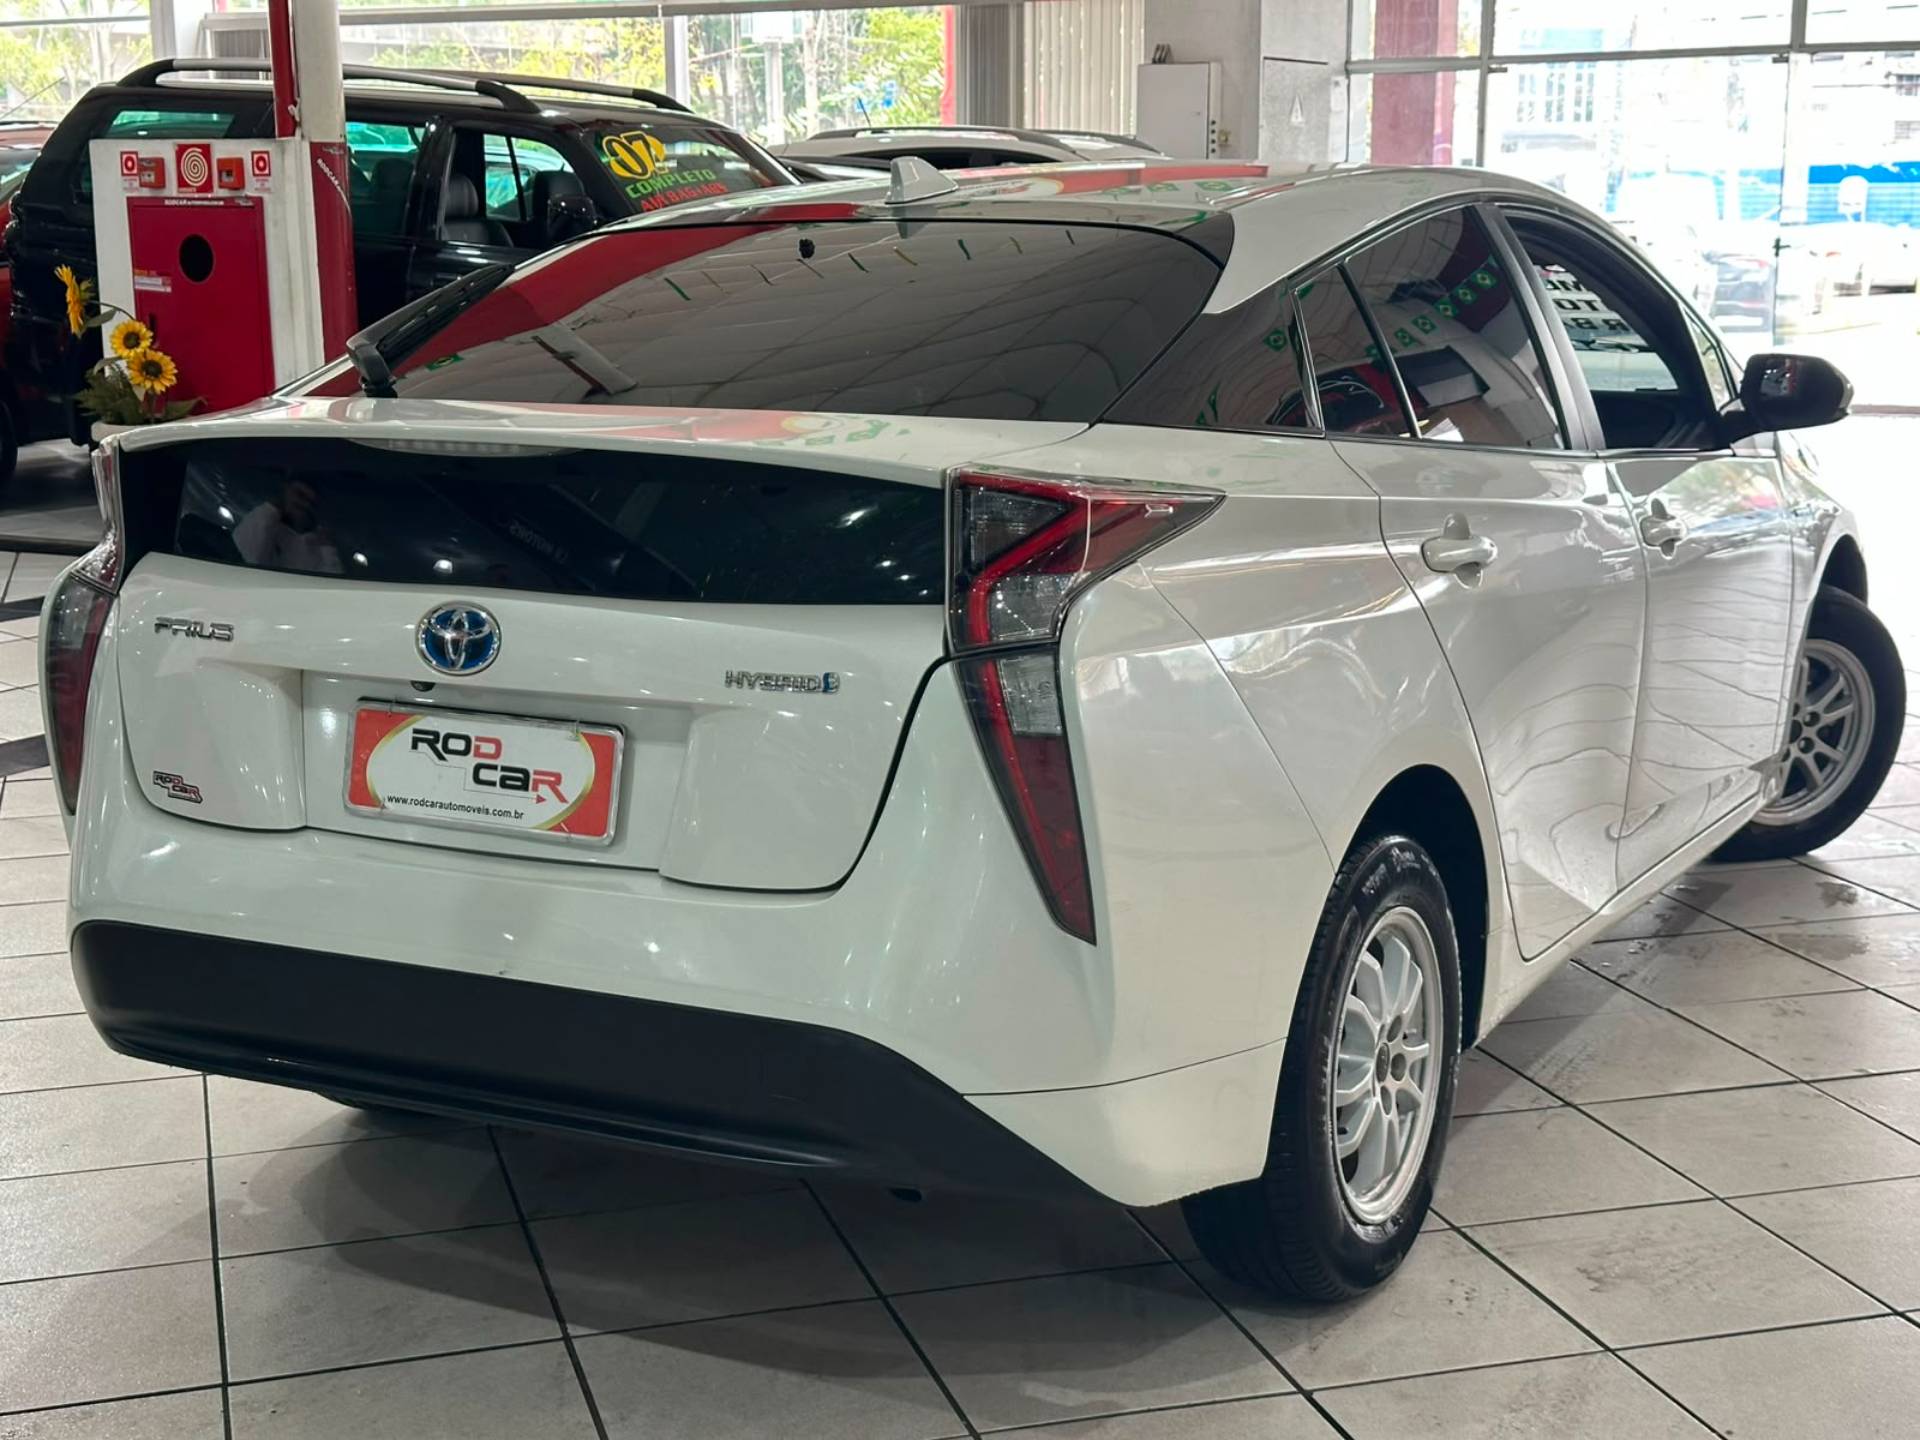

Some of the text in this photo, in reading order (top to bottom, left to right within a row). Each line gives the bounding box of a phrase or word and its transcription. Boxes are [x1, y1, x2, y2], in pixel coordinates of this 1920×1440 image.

[625, 169, 717, 199] COMPLETO
[154, 617, 235, 641] PRIUS
[724, 669, 822, 693] HYBRID
[411, 728, 502, 761] ROD
[155, 774, 181, 785] ROD
[387, 794, 525, 820] www.rodcarautomoveis.com.br
